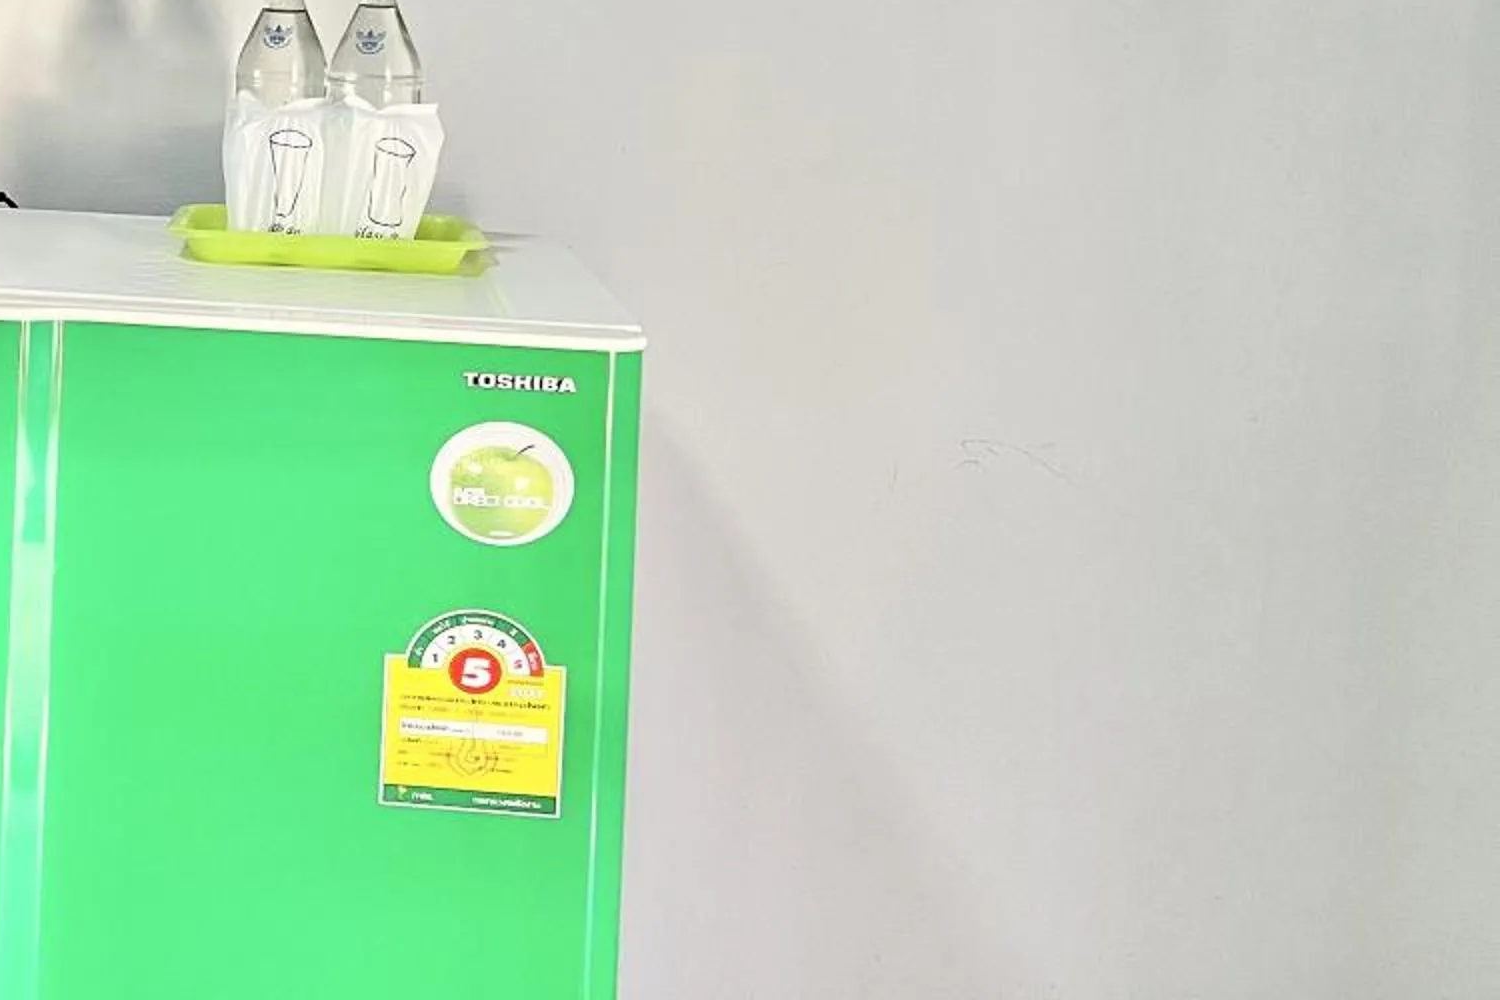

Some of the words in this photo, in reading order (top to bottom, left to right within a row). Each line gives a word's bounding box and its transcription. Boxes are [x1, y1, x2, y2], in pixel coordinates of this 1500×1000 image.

[463, 372, 576, 393] TOSHIBA
[432, 653, 438, 663] 1
[447, 635, 456, 645] 2
[473, 629, 483, 640] 3
[497, 639, 506, 649] 4
[461, 657, 491, 688] 5
